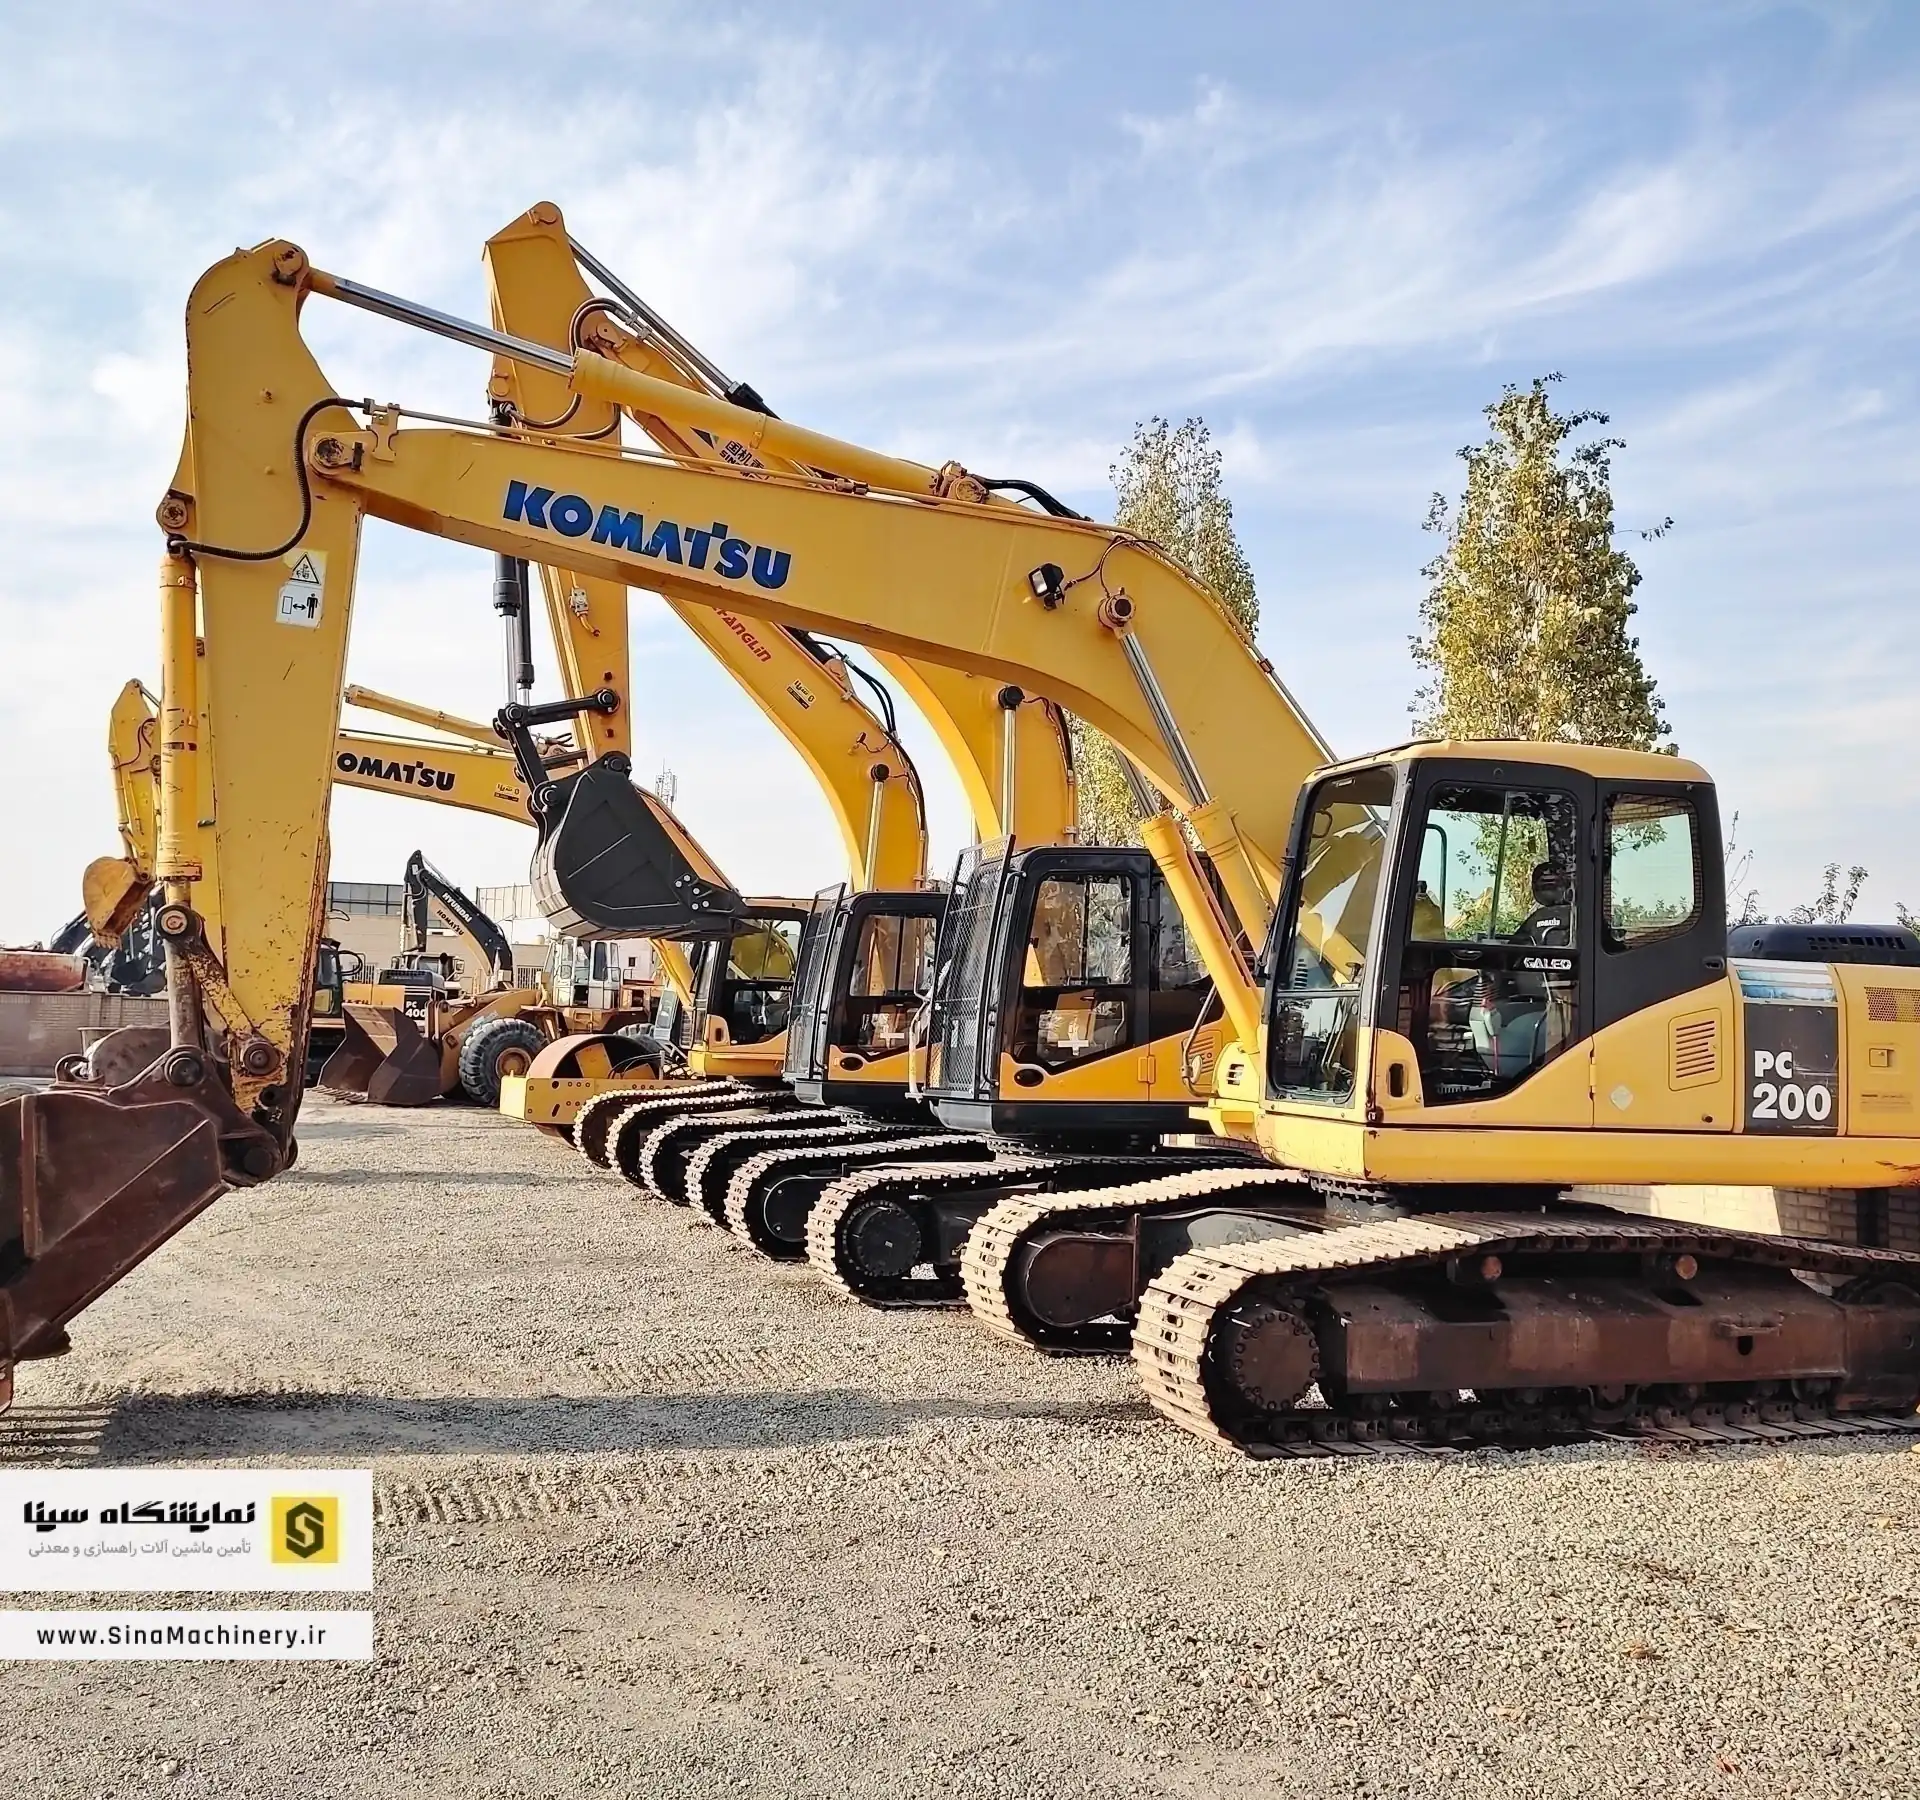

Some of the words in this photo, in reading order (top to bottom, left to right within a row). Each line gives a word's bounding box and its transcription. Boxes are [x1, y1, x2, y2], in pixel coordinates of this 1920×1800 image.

[503, 480, 792, 589] KOMATSU
[336, 751, 455, 791] OMATSU
[442, 892, 473, 923] HYUNDAI
[437, 909, 465, 936] KOMATSU
[1523, 957, 1572, 970] GALEO
[405, 1008, 426, 1018] 400
[406, 1000, 418, 1009] PC
[1754, 1050, 1793, 1079] PC
[1752, 1082, 1832, 1121] 200
